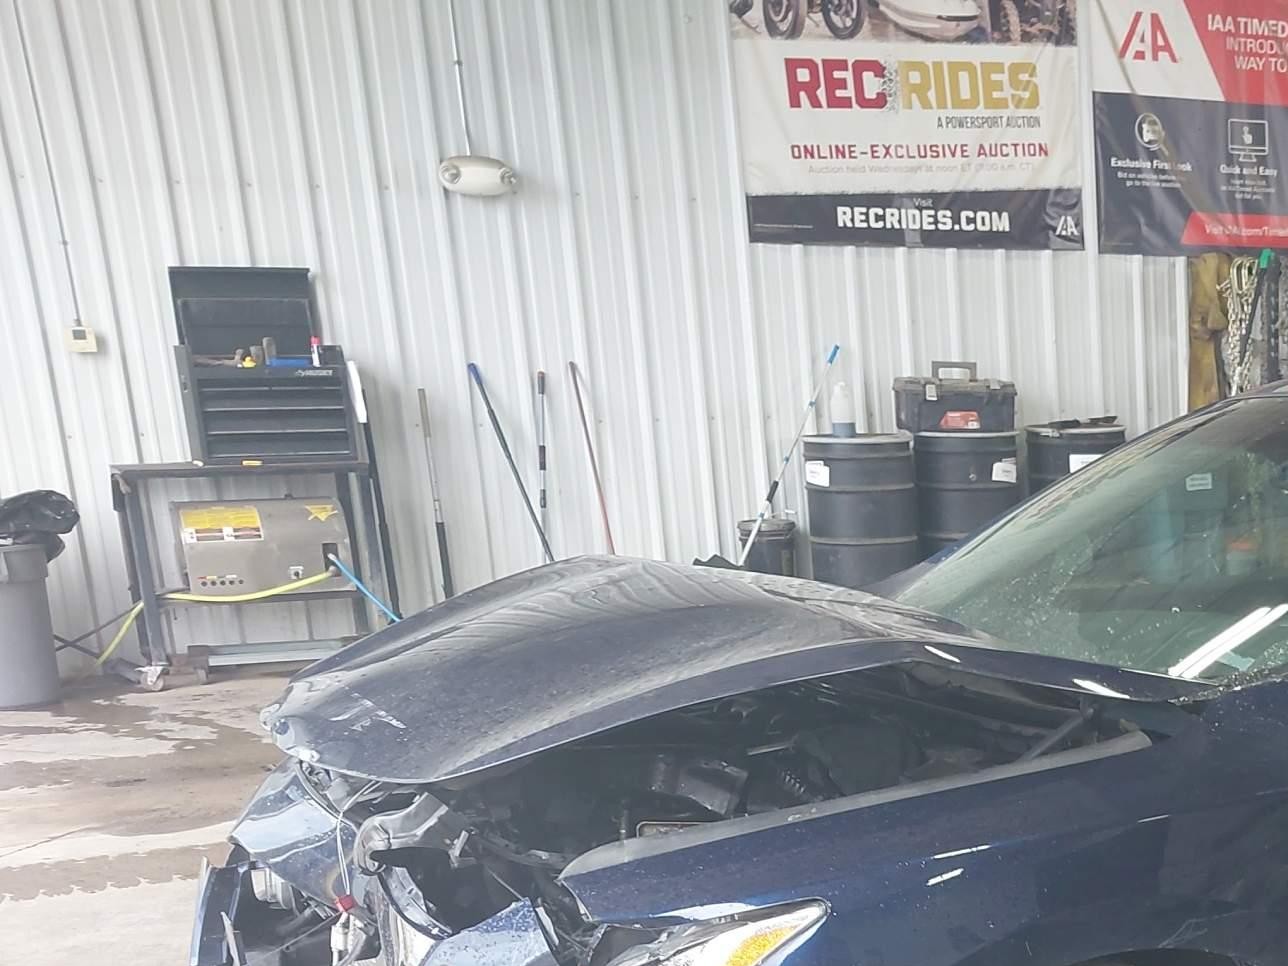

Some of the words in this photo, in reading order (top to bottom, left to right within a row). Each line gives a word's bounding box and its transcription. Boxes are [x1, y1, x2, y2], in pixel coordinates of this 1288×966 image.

[1207, 14, 1235, 32] IAA
[1237, 17, 1288, 38] TIMED
[1234, 55, 1265, 71] WAY
[1269, 58, 1287, 73] TO
[784, 58, 888, 110] REC
[897, 60, 1041, 110] RIDES
[937, 116, 944, 128] A
[945, 116, 1004, 128] POWERSPORT
[1006, 116, 1041, 128] AUCTION
[790, 144, 970, 159] ONLINE-EXCLUSIVE
[977, 142, 1049, 157] AUCTION
[913, 198, 934, 207] Visit
[837, 205, 1011, 233] RECRIDES.COM
